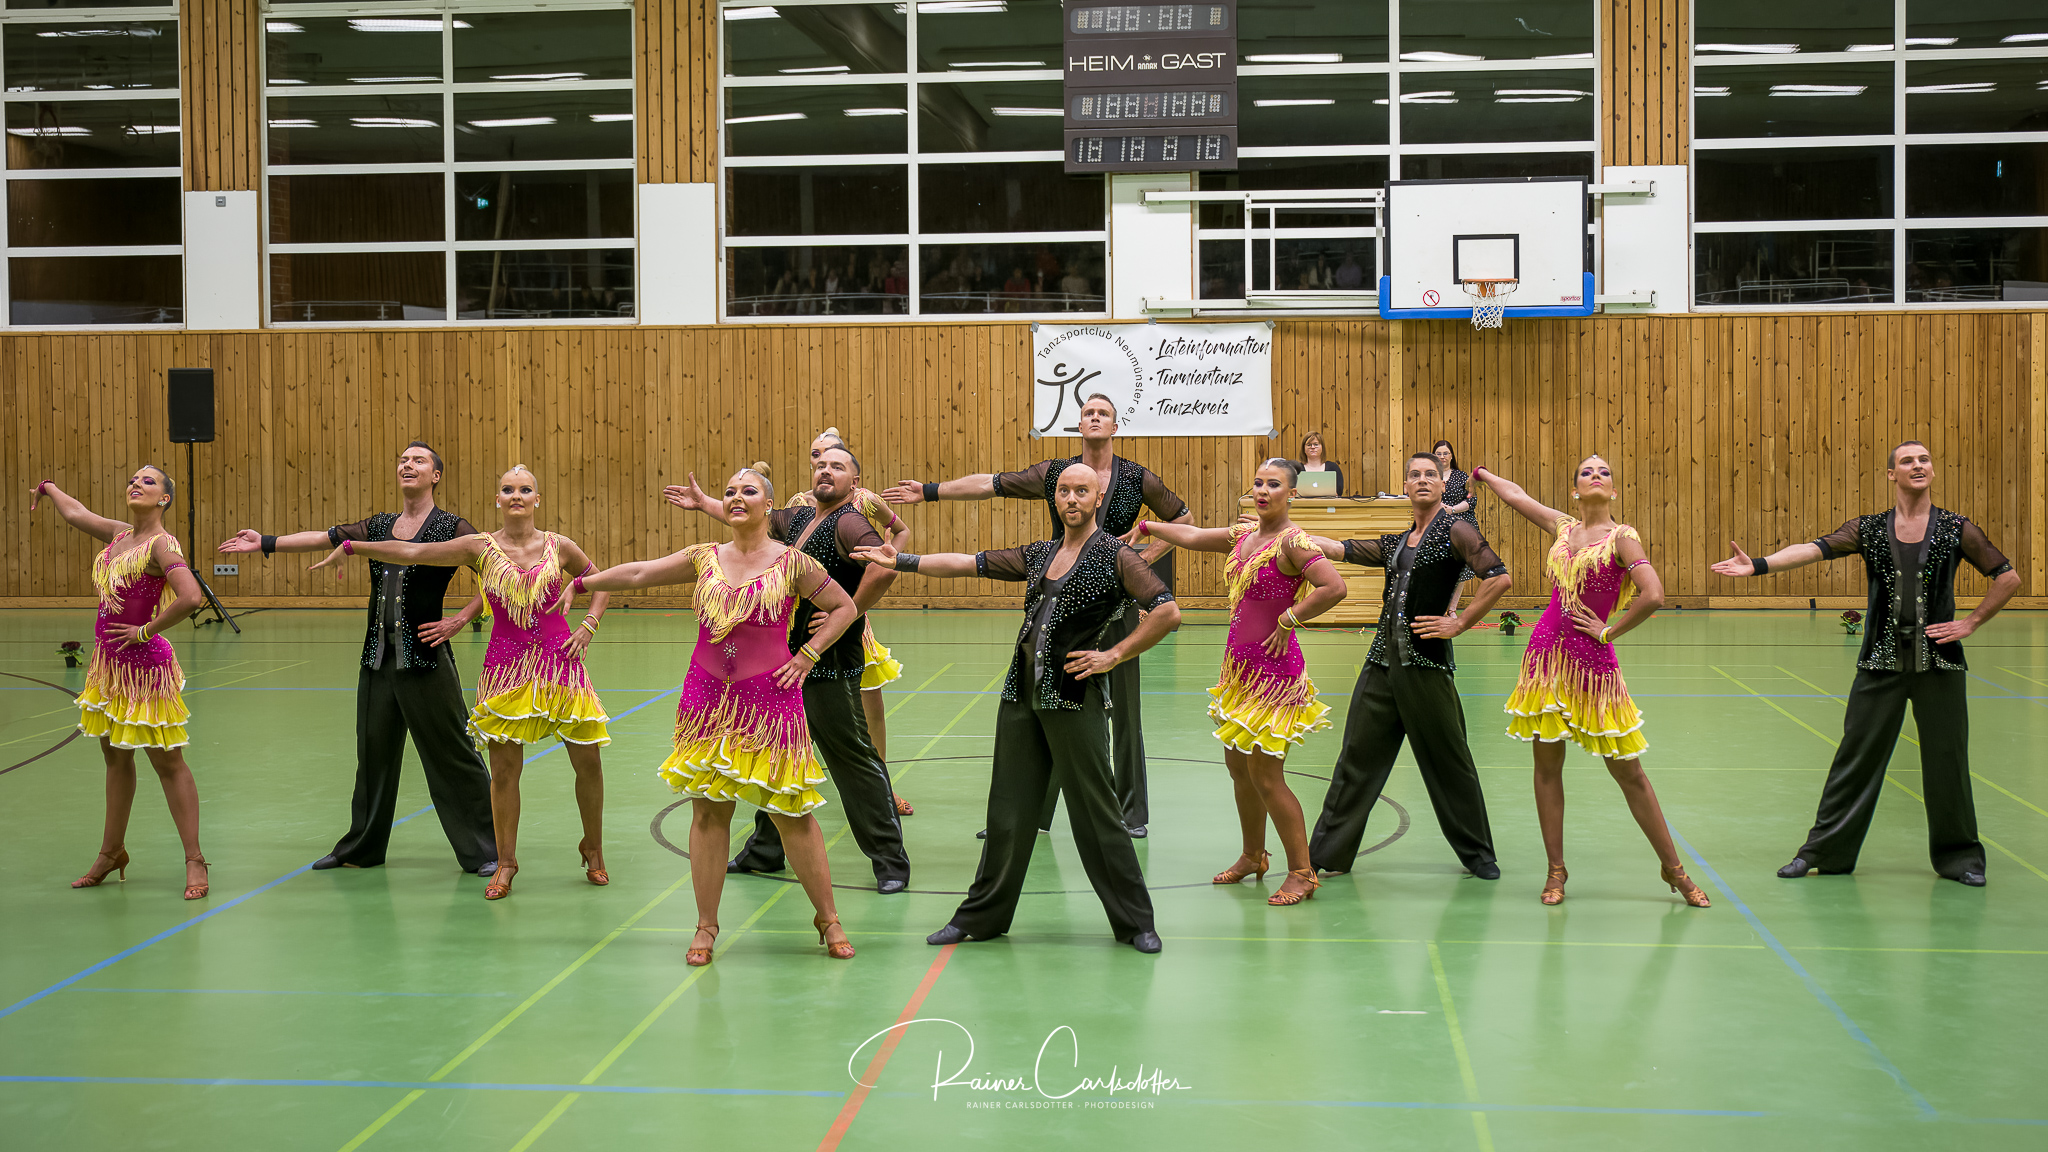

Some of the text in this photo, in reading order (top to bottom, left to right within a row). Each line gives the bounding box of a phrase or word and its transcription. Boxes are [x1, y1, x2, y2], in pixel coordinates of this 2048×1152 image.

[1069, 52, 1227, 72] HEIM ANNAX GAST
[1155, 335, 1270, 361] Lateinformation
[1037, 326, 1113, 360] Tanzsportclub
[1114, 336, 1144, 405] Neumünster
[1156, 366, 1244, 387] Turniertanz
[1156, 398, 1229, 417] Tanzkreis
